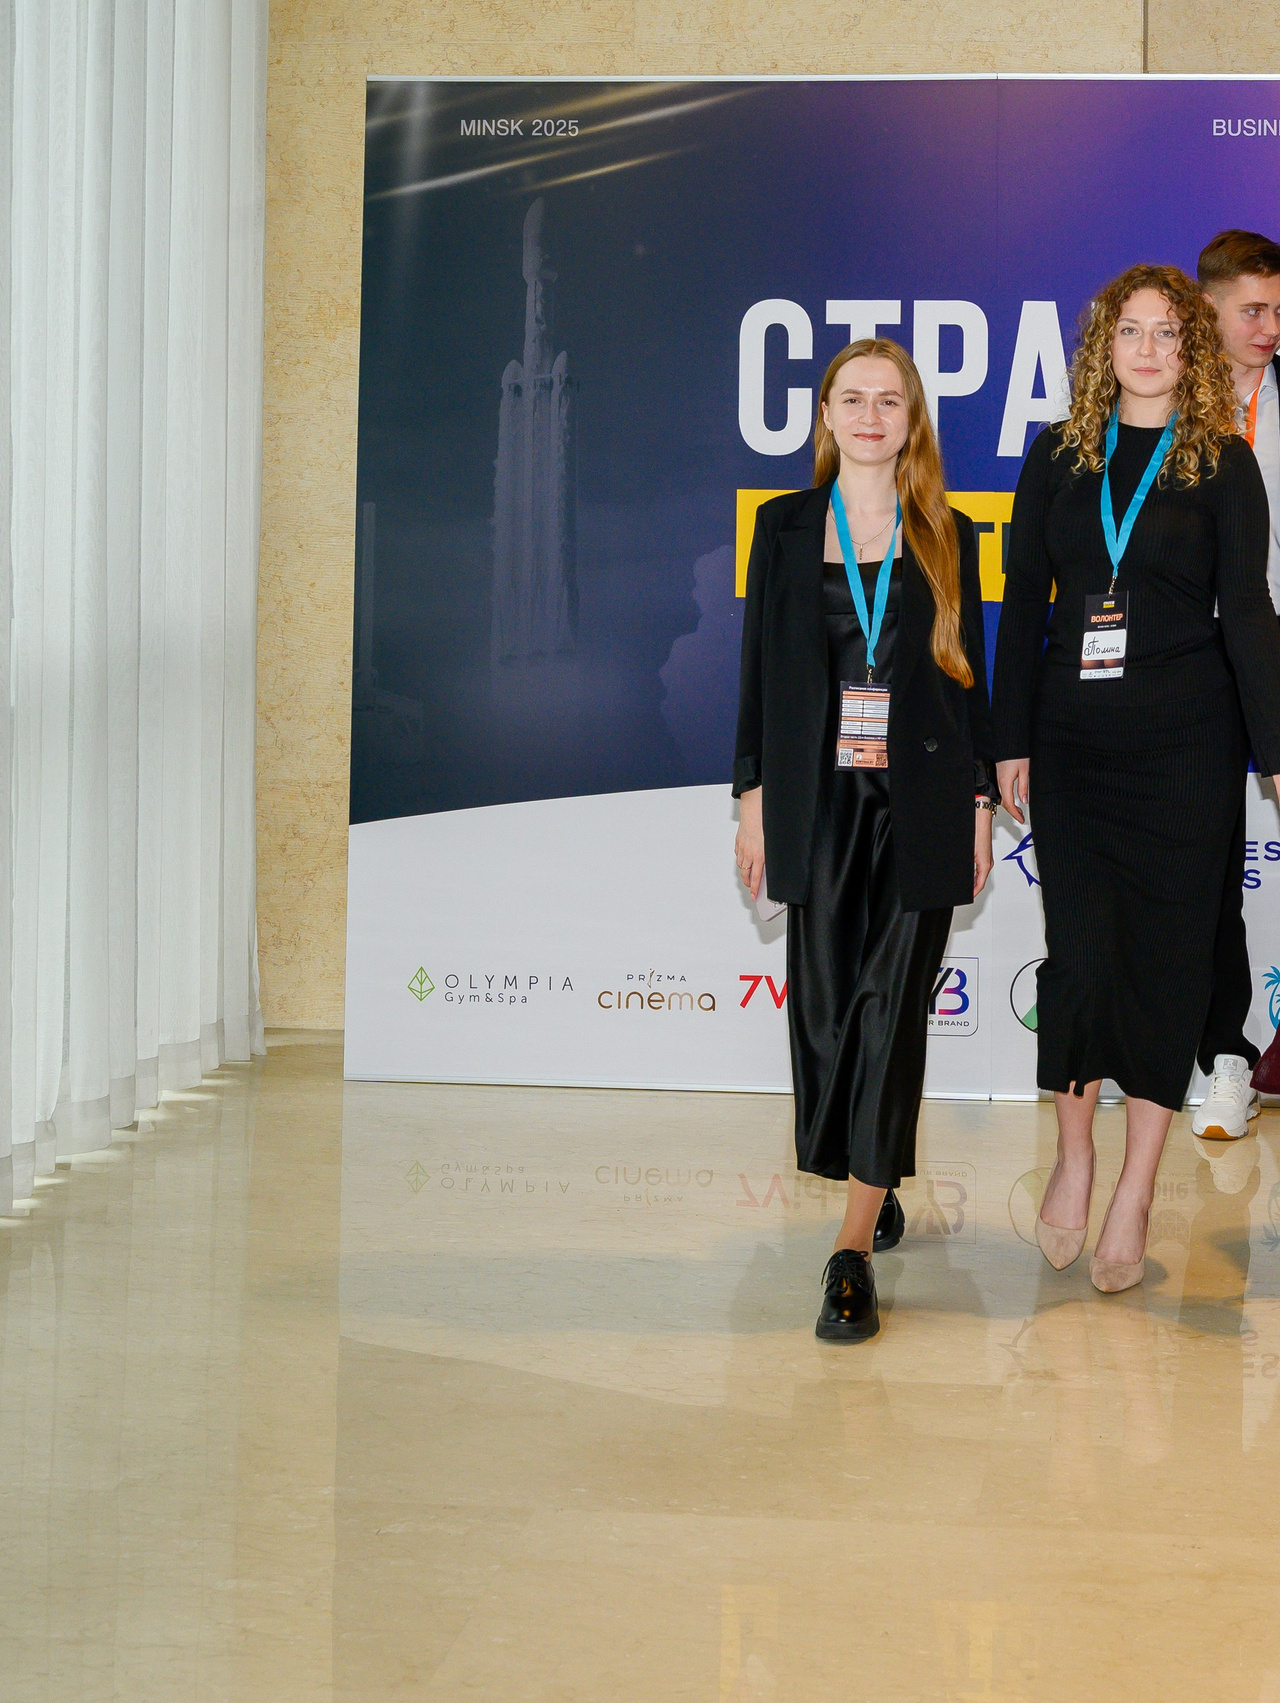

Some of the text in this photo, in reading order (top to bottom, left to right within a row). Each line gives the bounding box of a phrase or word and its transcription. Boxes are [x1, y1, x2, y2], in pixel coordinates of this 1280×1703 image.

[460, 119, 579, 137] MINSK 2025
[444, 973, 574, 992] OLYMPIA
[626, 968, 687, 988] PRIZMA
[444, 992, 528, 1005] Gym&Spa
[597, 990, 716, 1012] cinema
[938, 1019, 970, 1028] BRAND
